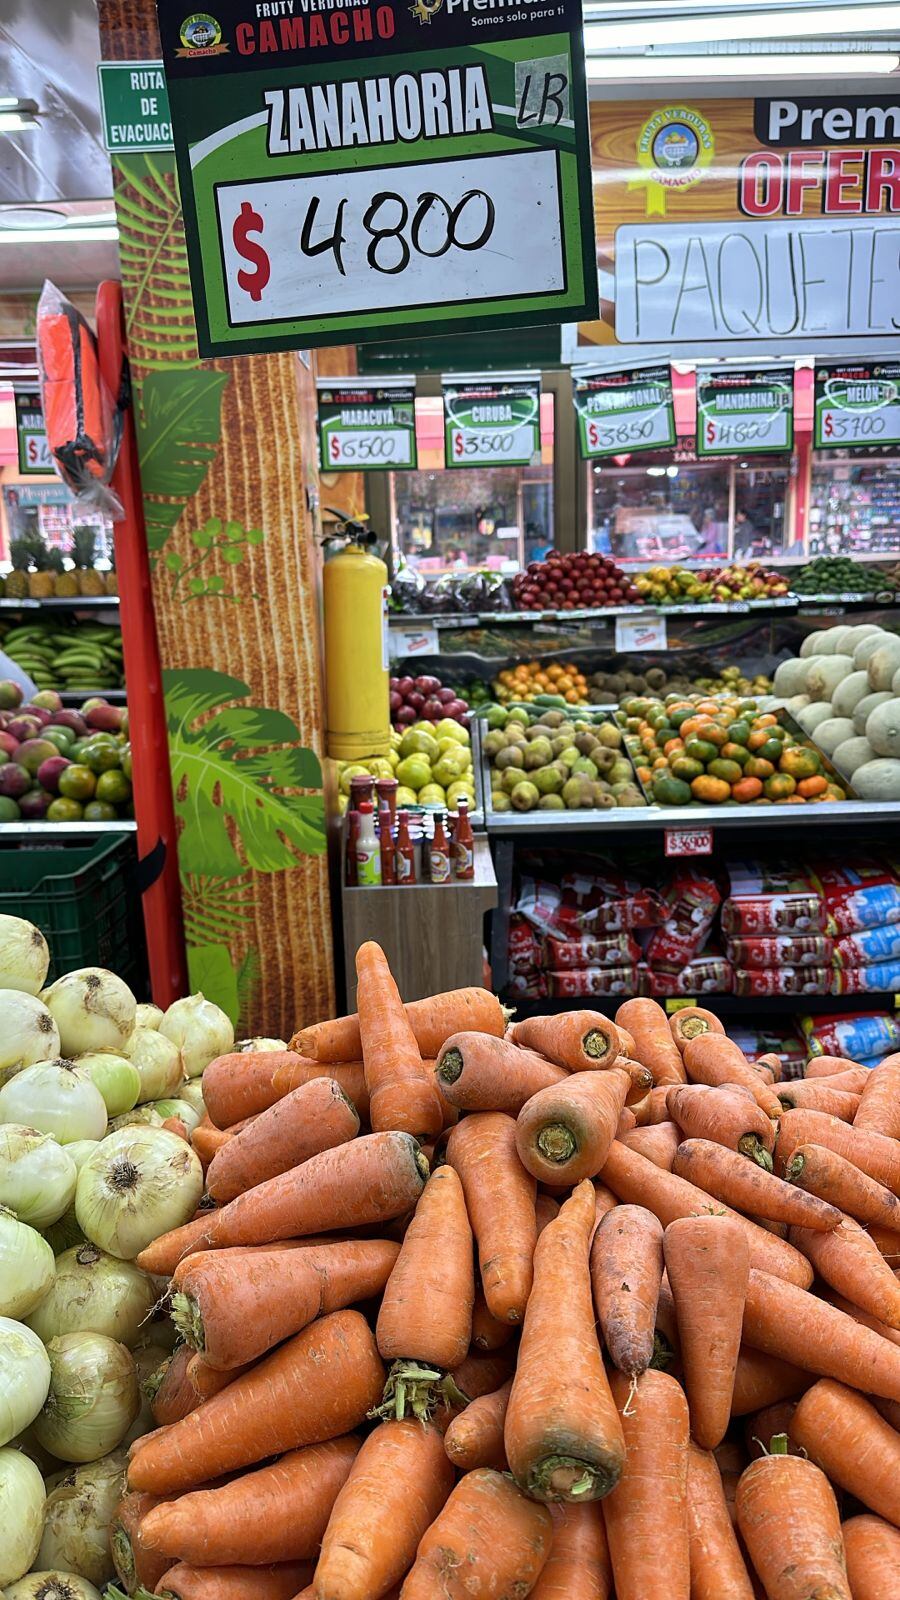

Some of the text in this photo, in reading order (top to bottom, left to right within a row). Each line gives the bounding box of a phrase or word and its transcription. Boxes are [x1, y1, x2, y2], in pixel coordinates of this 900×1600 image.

[256, 0, 294, 18] FRUTY
[447, 0, 548, 14] Prem
[471, 5, 565, 27] Somos solo para ti
[235, 5, 395, 56] CAMACHO
[130, 71, 165, 90] RUTA
[141, 97, 158, 116] DE
[265, 66, 493, 154] ZANAHORIA
[768, 100, 900, 141] Prem
[739, 149, 900, 217] OFER
[300, 189, 495, 276] 4800
[715, 392, 774, 410] MANDARINA
[846, 384, 879, 402] MELÓN
[341, 406, 394, 426] MARACUYÁ
[471, 405, 512, 422] CURUBA
